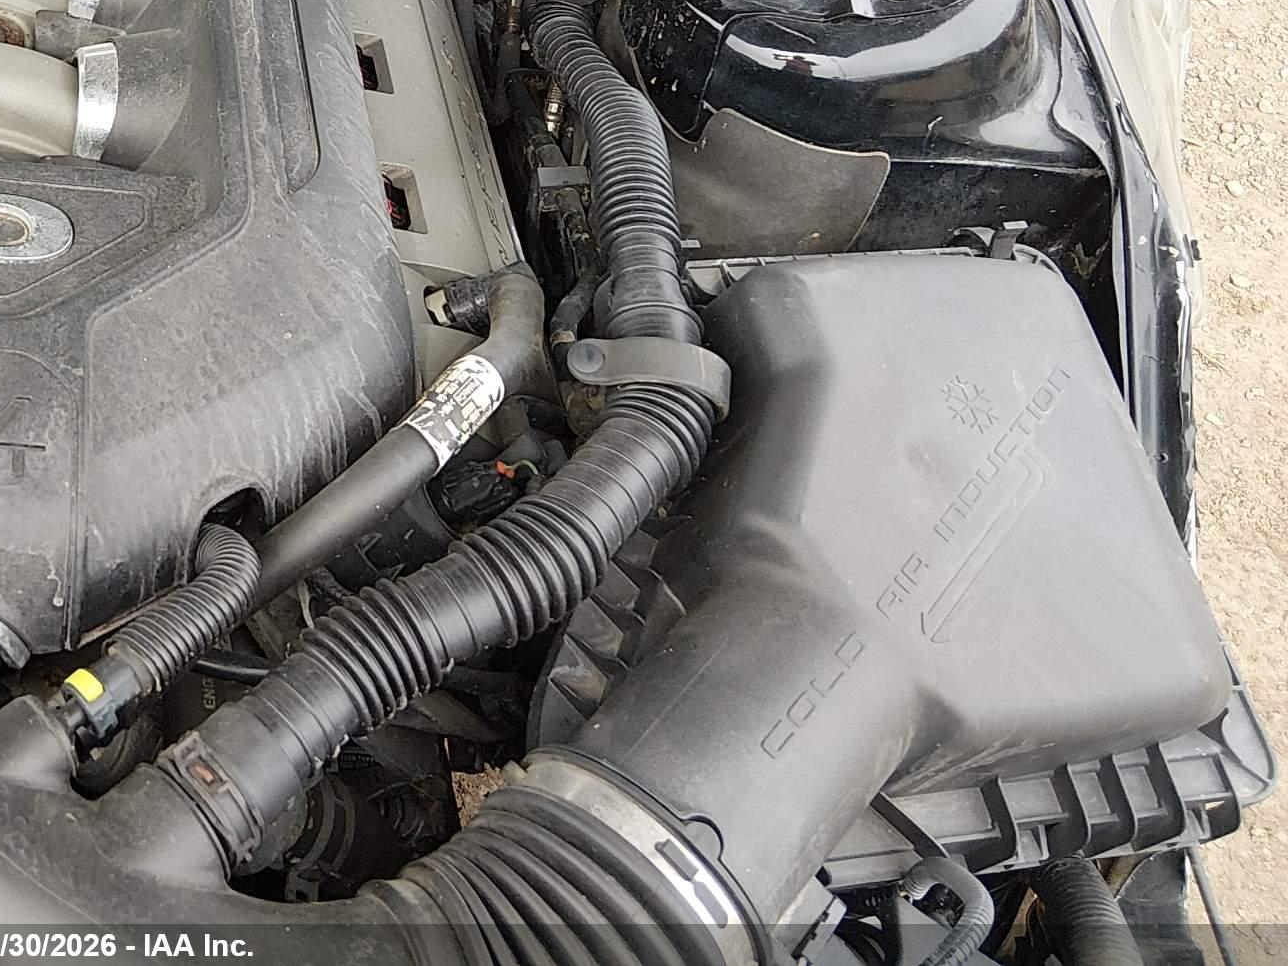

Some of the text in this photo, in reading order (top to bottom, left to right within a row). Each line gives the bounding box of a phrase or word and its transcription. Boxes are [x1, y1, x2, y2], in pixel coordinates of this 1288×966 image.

[760, 365, 1073, 760] COLD AIR INDUCTION
